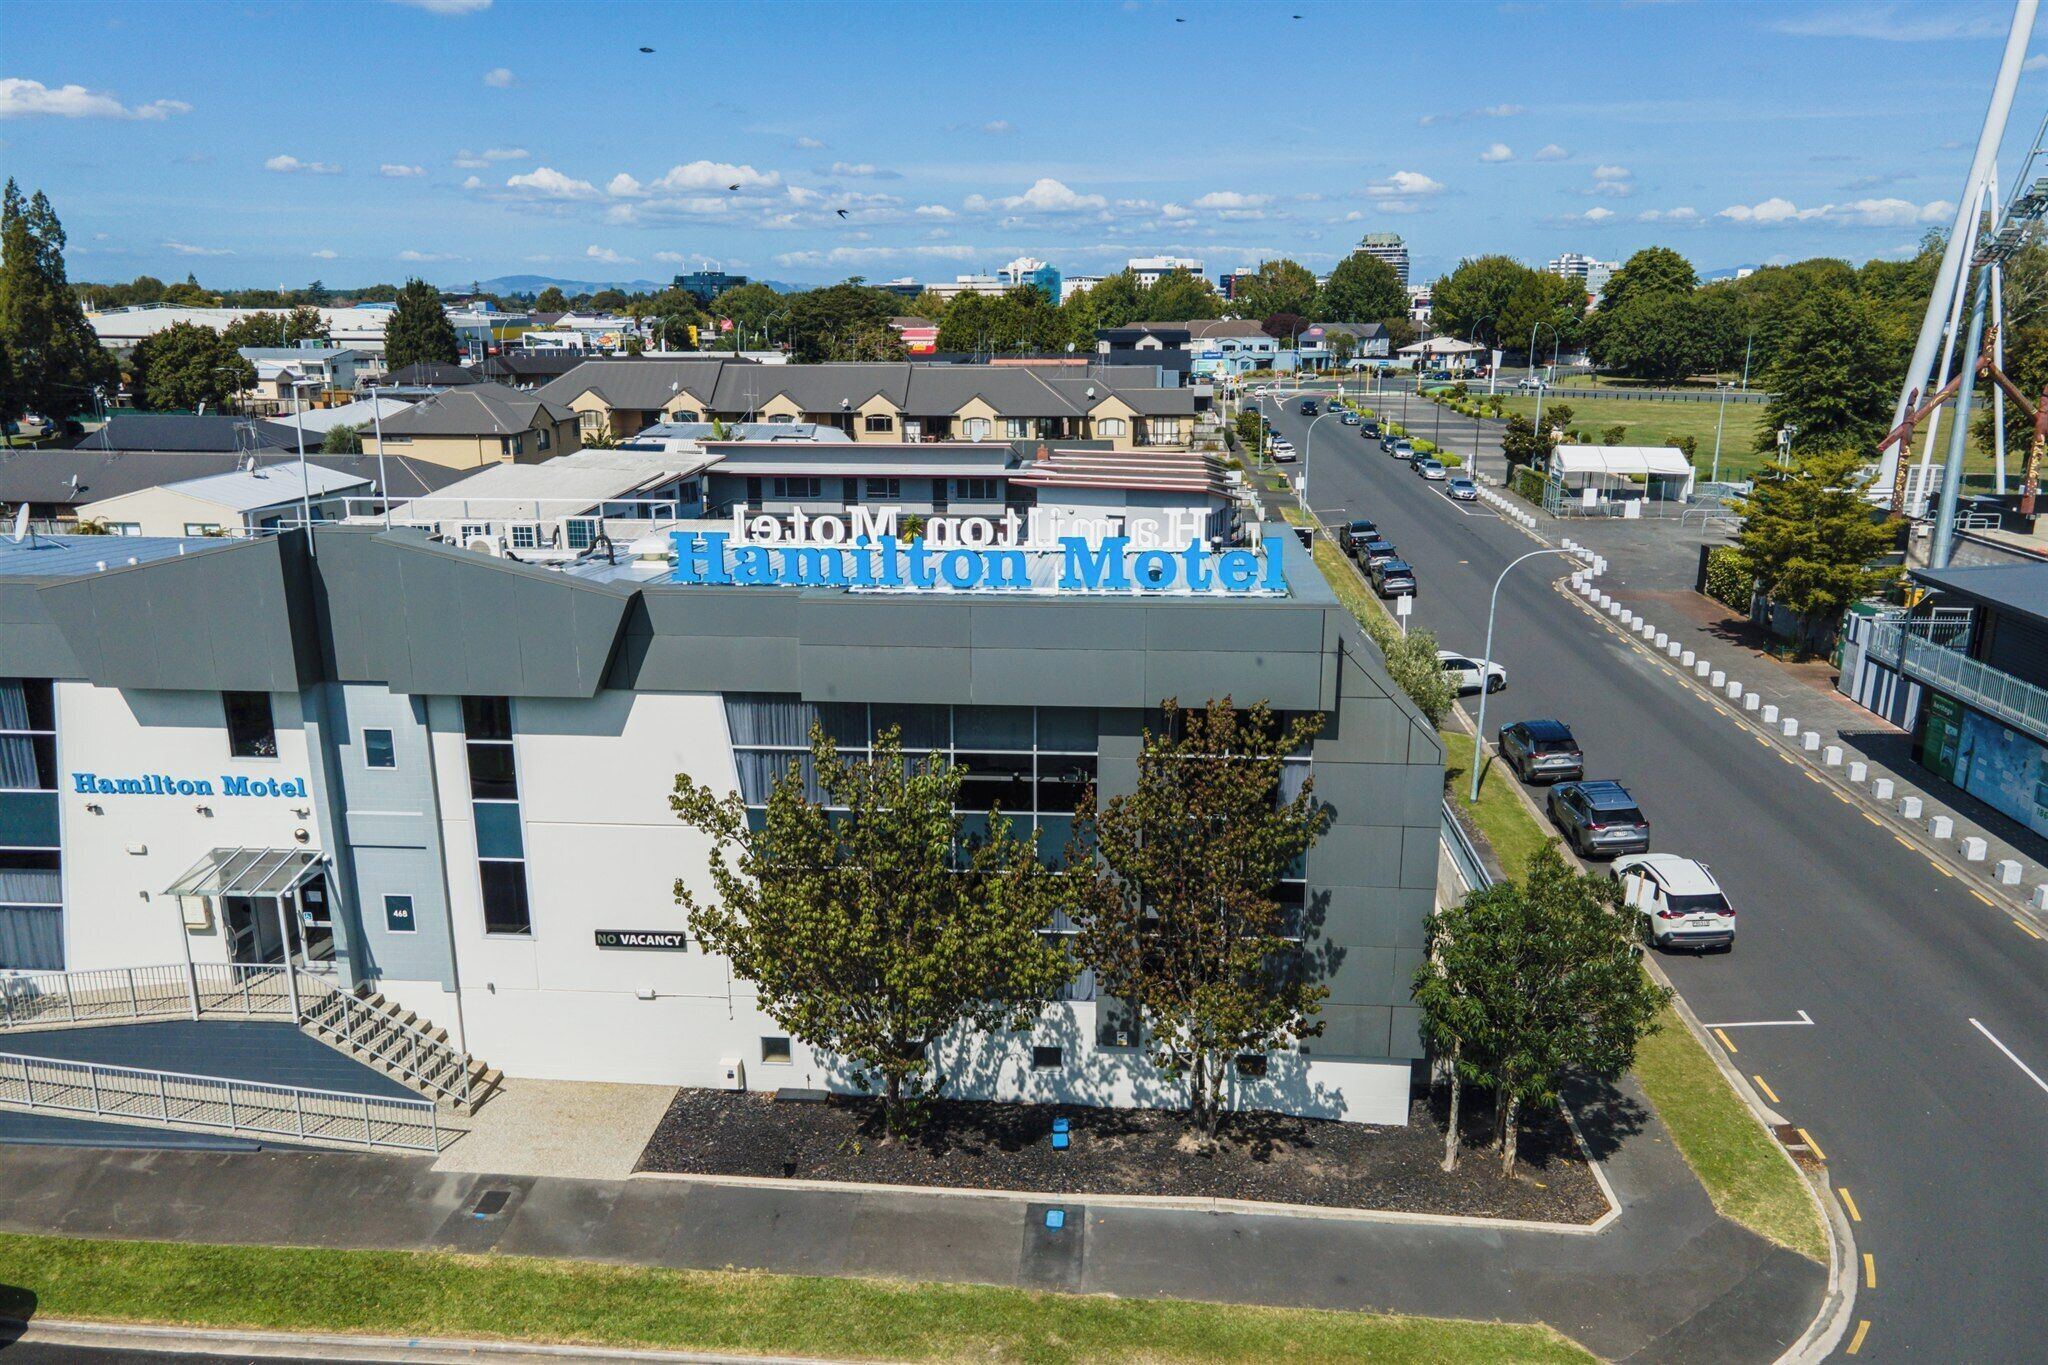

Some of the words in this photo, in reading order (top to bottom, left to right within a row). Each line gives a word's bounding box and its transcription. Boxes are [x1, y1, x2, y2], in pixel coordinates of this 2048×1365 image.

[669, 531, 1032, 589] Hamilton
[1058, 536, 1288, 592] Motel
[72, 773, 214, 796] Hamilton
[220, 775, 308, 798] Motel
[393, 909, 408, 918] 468
[597, 934, 617, 944] NO
[619, 934, 682, 946] VACANCY
